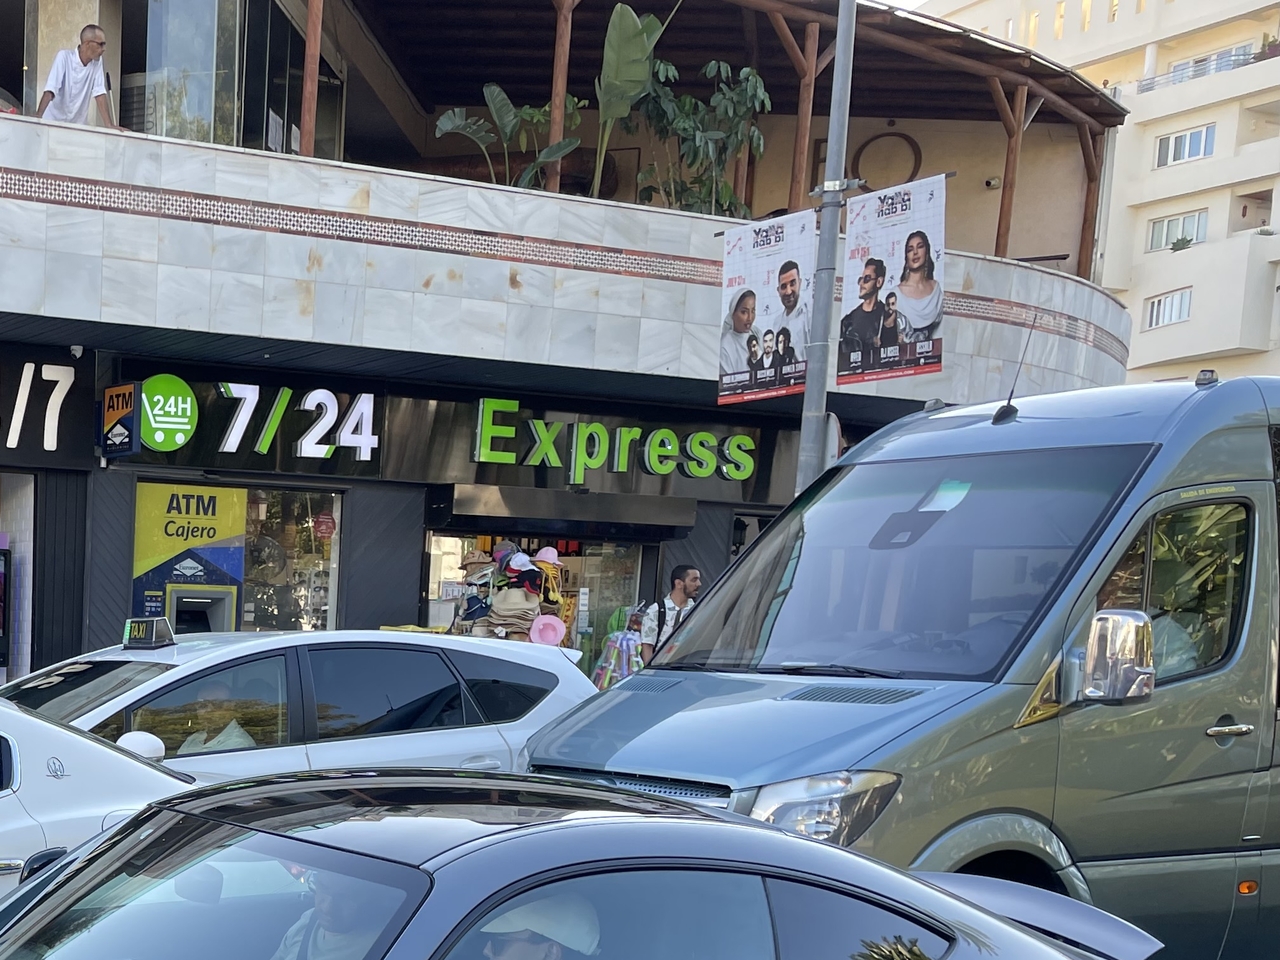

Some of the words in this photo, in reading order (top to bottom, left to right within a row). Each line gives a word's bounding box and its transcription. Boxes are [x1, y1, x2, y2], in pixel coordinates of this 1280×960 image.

[107, 391, 133, 413] ATM
[152, 395, 192, 416] 24H
[217, 382, 379, 461] 7/24
[475, 397, 756, 485] Express
[166, 493, 217, 516] ATM
[164, 520, 217, 541] Cajero
[131, 623, 147, 638] TAXI
